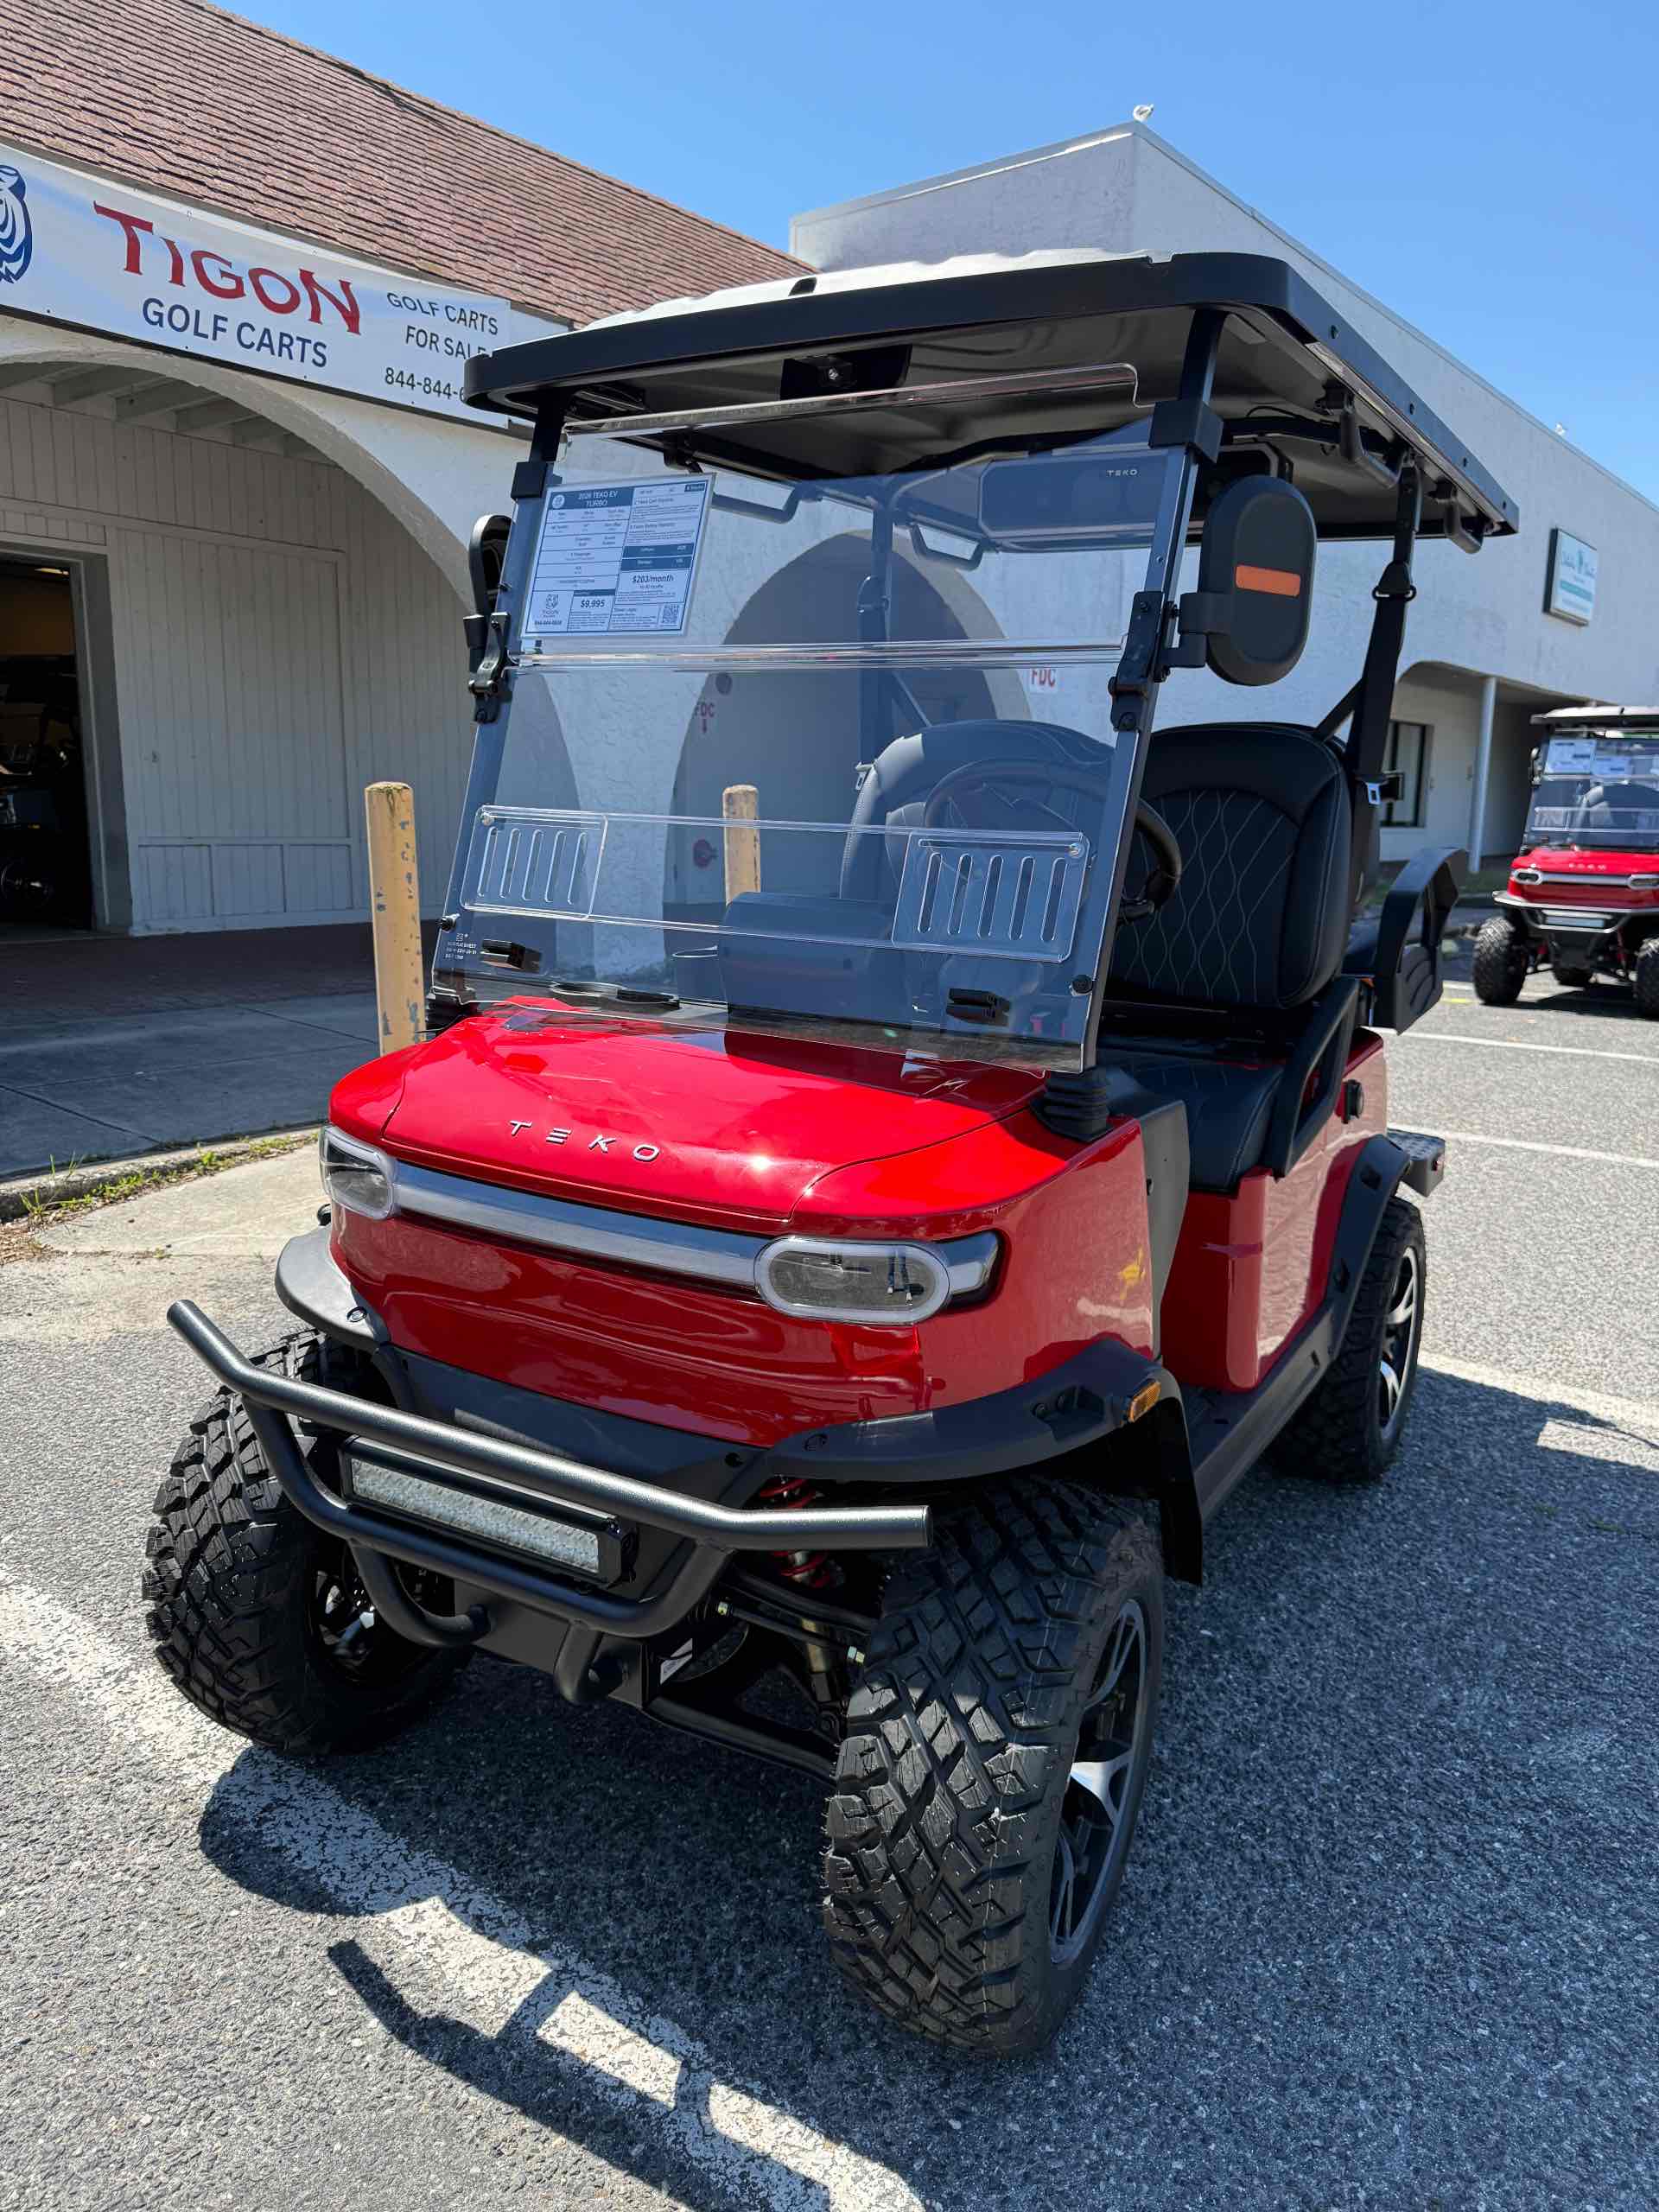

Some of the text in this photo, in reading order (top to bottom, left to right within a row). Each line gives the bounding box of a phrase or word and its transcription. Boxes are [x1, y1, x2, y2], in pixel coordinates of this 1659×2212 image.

[92, 200, 361, 335] TIGON
[142, 297, 328, 369] GOLF CARTS
[386, 292, 499, 336] GOLF CARTS
[404, 325, 441, 353] FOR
[580, 599, 606, 608] $9,995
[1031, 668, 1056, 688] FDC
[509, 1119, 662, 1162] TEKO
